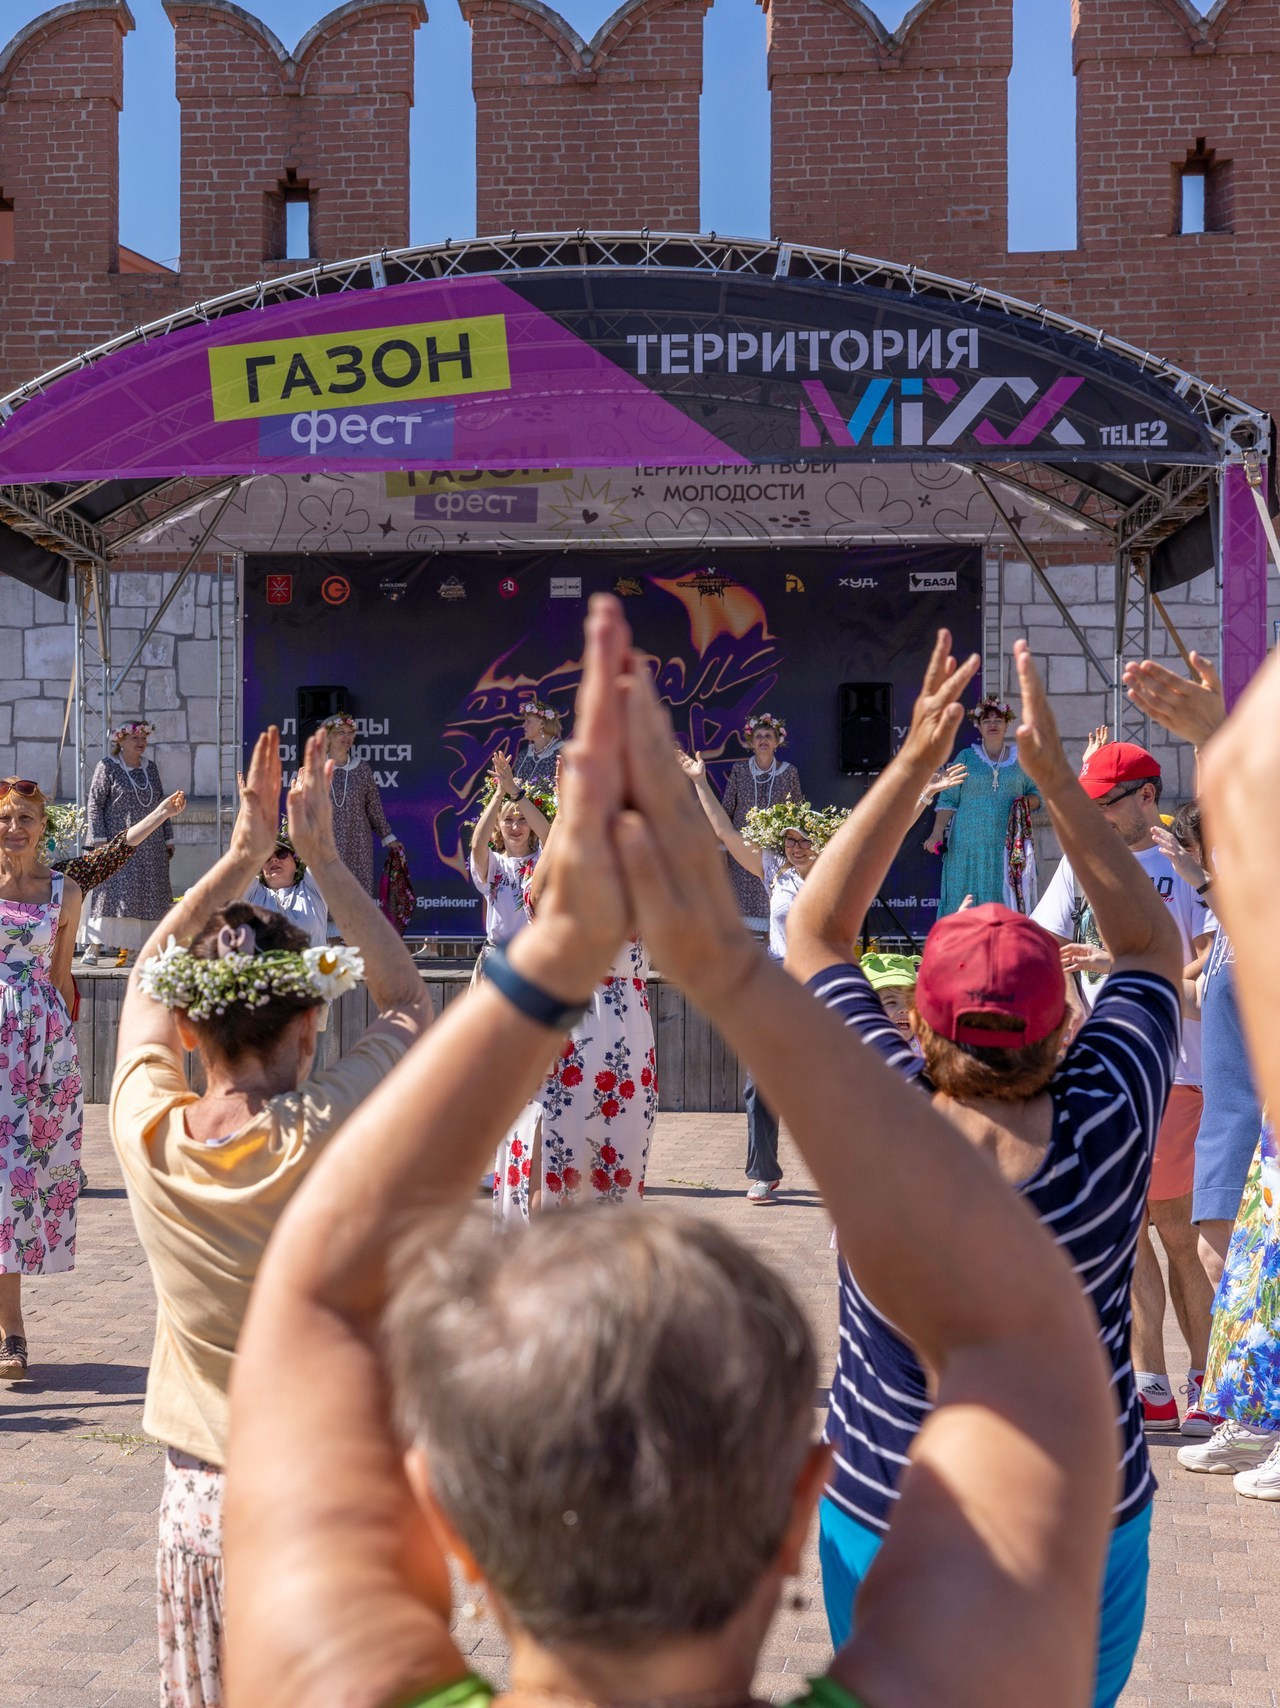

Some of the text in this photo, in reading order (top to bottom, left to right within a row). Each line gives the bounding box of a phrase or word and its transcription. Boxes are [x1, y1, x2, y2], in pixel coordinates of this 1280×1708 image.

[626, 327, 980, 375] ТЕРРИТОРИЯ
[245, 333, 473, 403] ГАЗОН
[290, 409, 422, 454] фест
[1099, 420, 1168, 446] TELE2
[434, 491, 518, 519] фест
[663, 483, 805, 504] МОЛОДОСТИ
[923, 577, 956, 587] БАЗА
